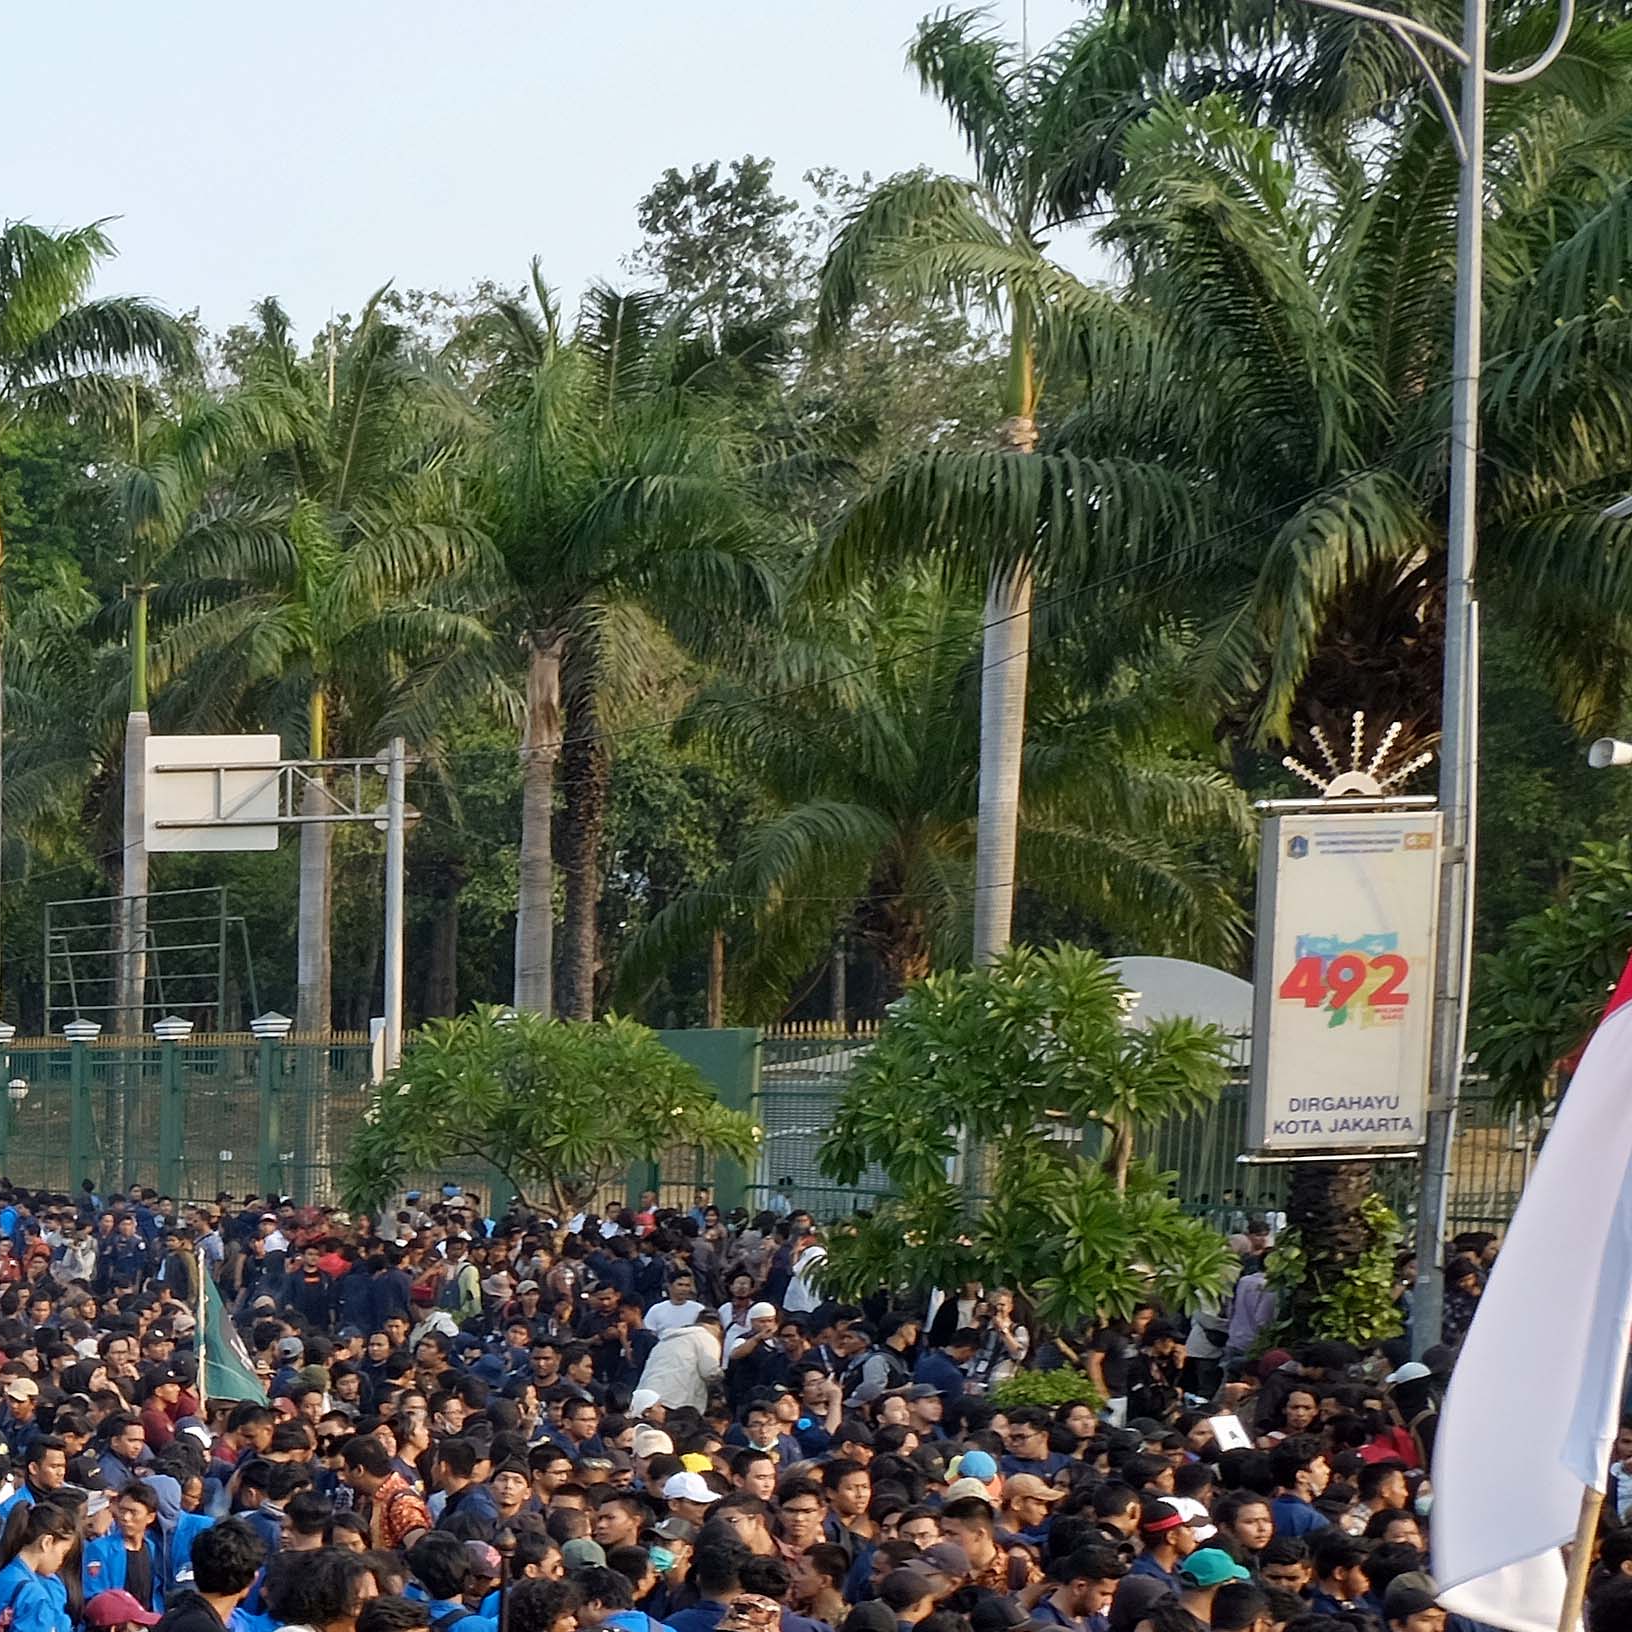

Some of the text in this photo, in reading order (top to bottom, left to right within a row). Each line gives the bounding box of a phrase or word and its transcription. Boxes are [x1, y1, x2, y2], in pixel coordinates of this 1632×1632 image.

[1279, 954, 1409, 1009] 492
[1288, 1096, 1400, 1112] DIRGAHAYU
[1273, 1117, 1413, 1135] KOTA JAKARTA
